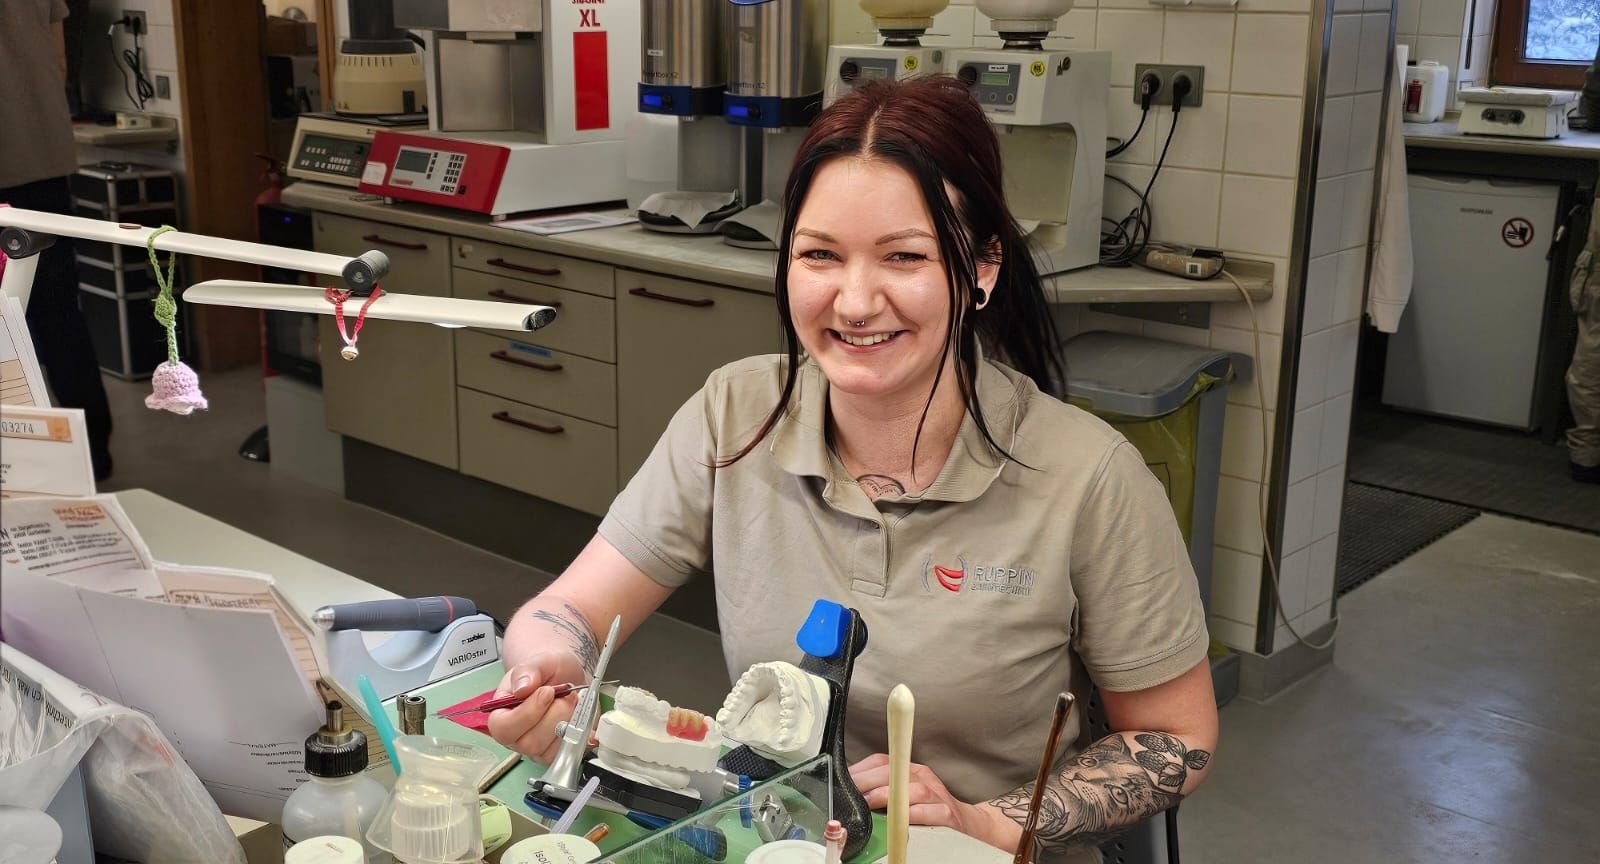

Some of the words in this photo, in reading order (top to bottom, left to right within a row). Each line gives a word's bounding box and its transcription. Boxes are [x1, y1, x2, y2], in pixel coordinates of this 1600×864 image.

[579, 9, 601, 27] XL
[1, 421, 34, 434] 03274
[975, 566, 1034, 585] RUPPIN
[448, 649, 487, 666] VARIOstar
